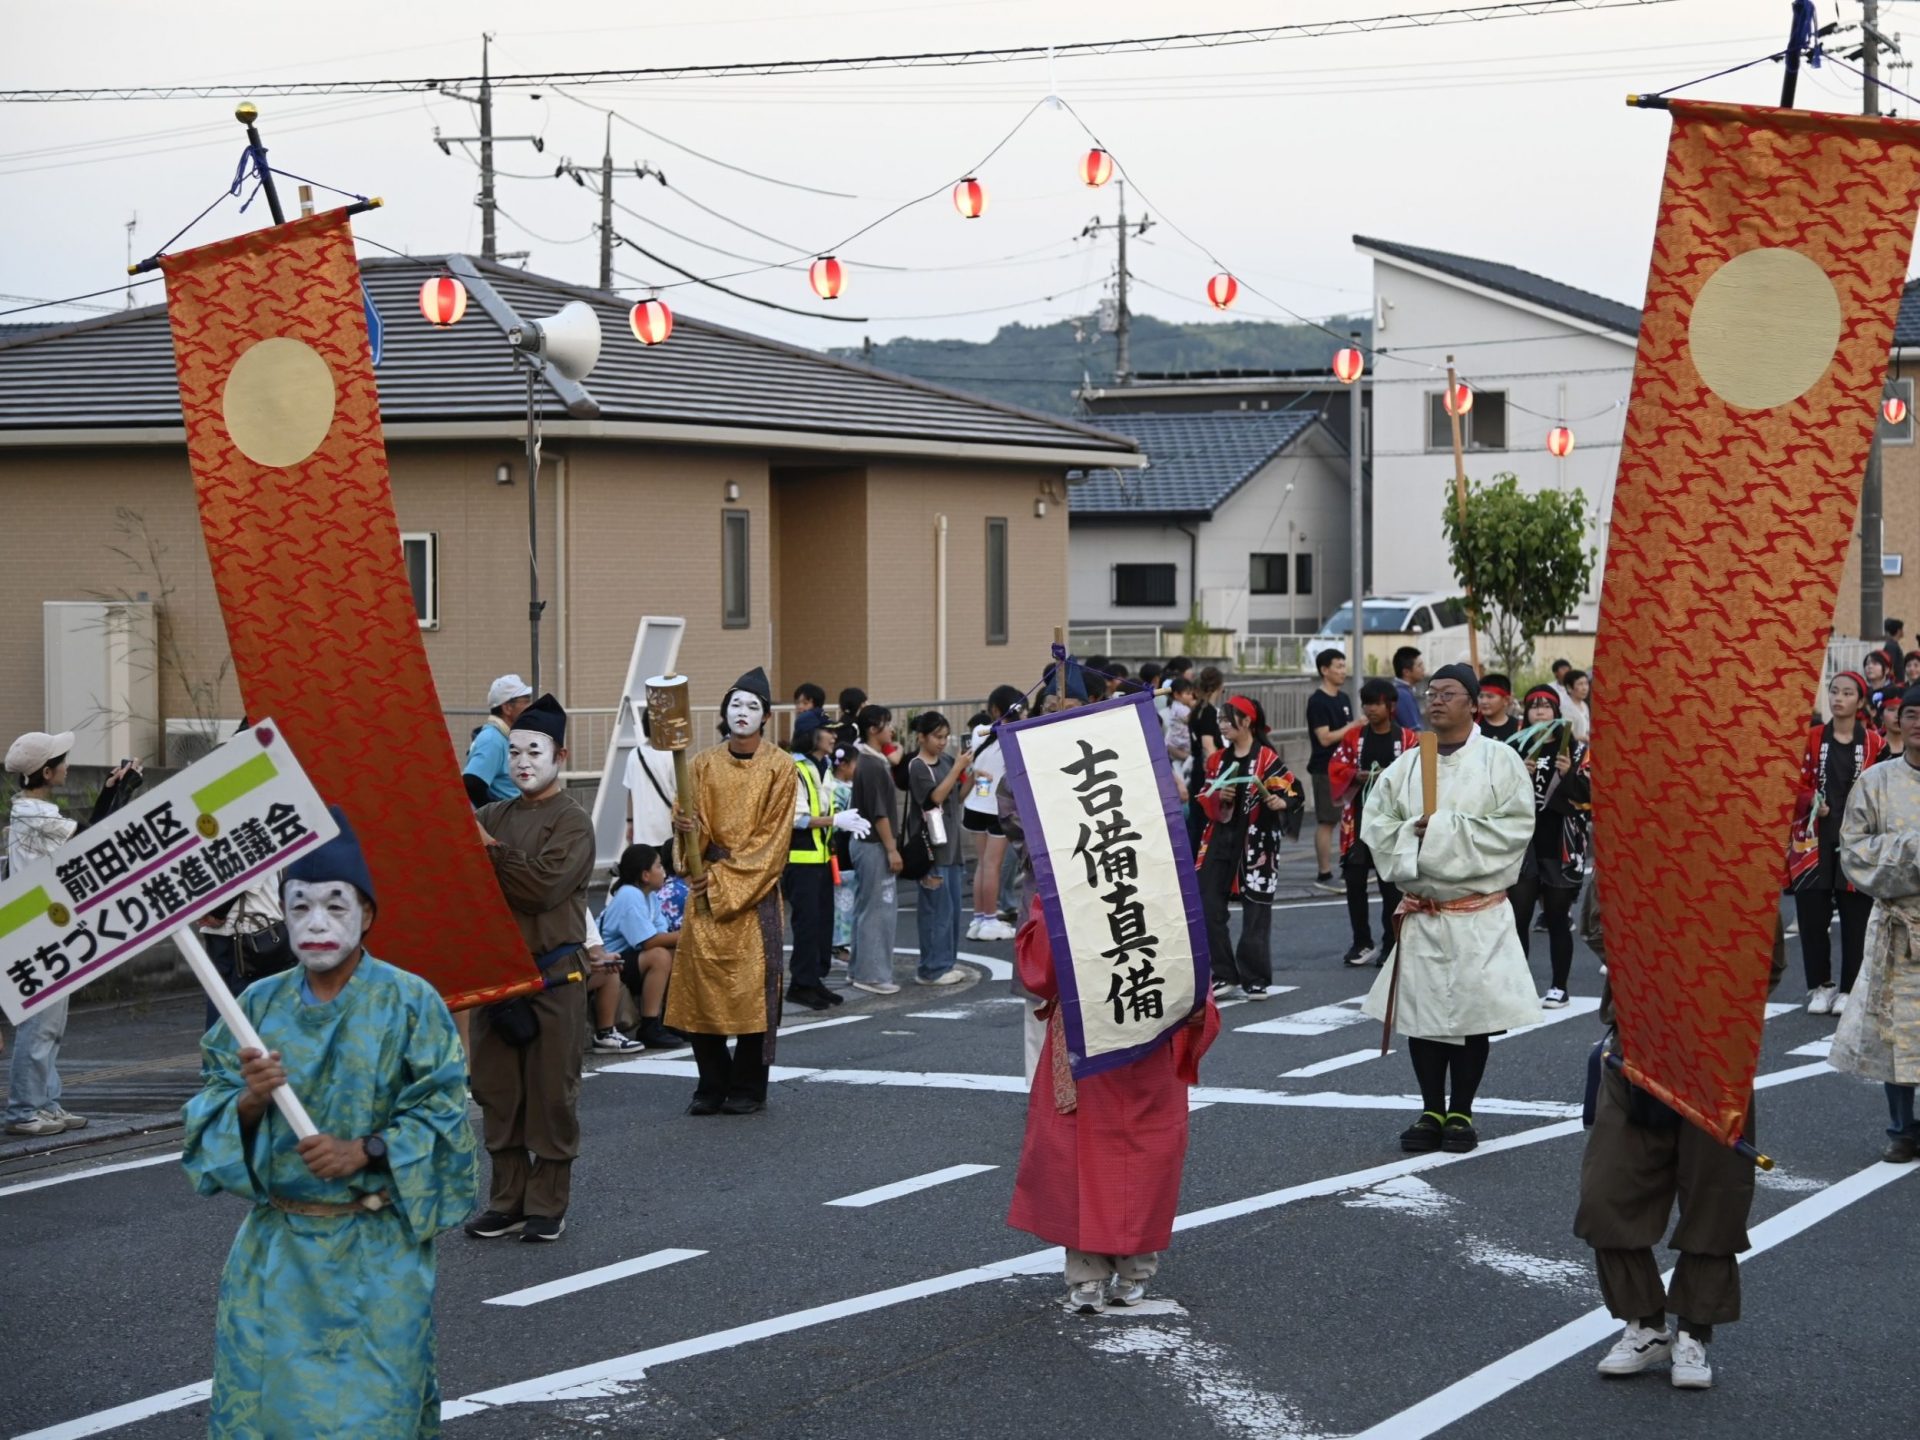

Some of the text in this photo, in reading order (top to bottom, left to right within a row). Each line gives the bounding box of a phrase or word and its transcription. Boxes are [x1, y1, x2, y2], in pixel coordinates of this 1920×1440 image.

[6, 801, 309, 997] まちづくり推進協議会
[55, 800, 190, 904] 箭田地区
[1059, 739, 1165, 1025] 吉備真備
